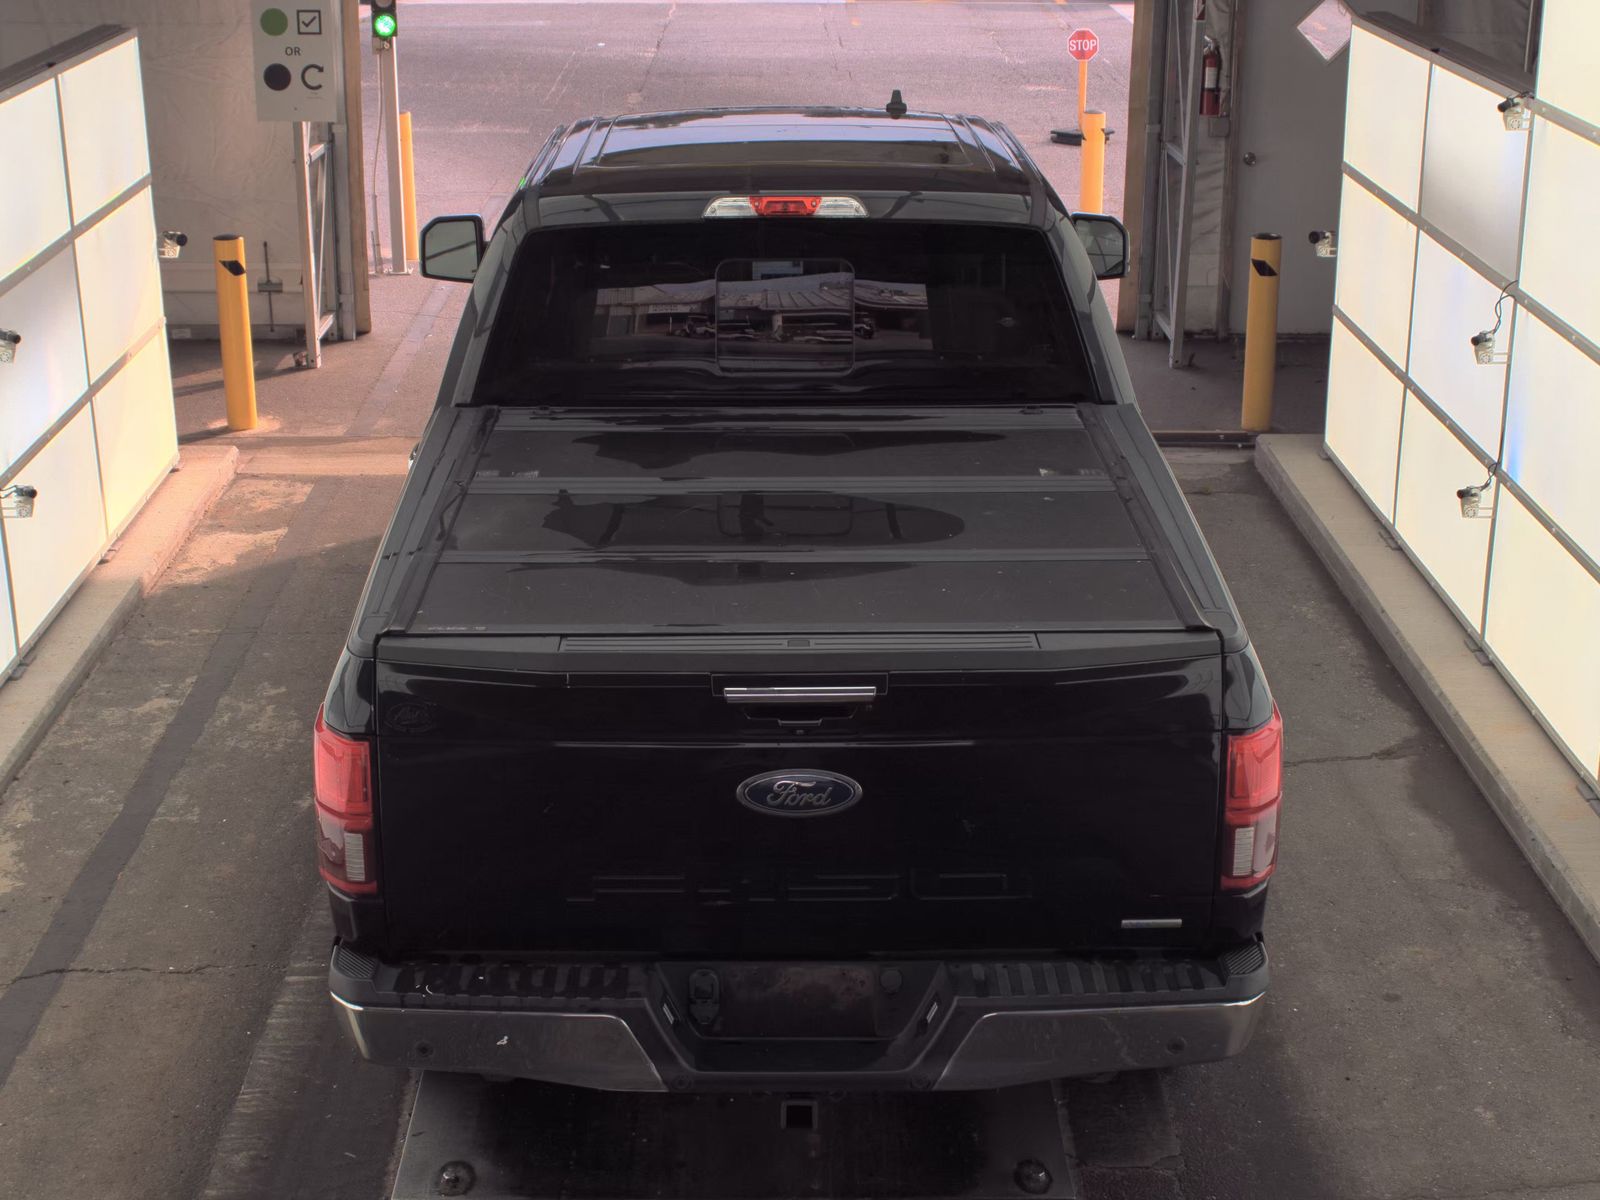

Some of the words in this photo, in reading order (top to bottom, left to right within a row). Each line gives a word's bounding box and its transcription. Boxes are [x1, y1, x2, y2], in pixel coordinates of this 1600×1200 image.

[285, 46, 301, 56] OR
[1069, 39, 1097, 51] STOP
[766, 780, 832, 806] Ford
